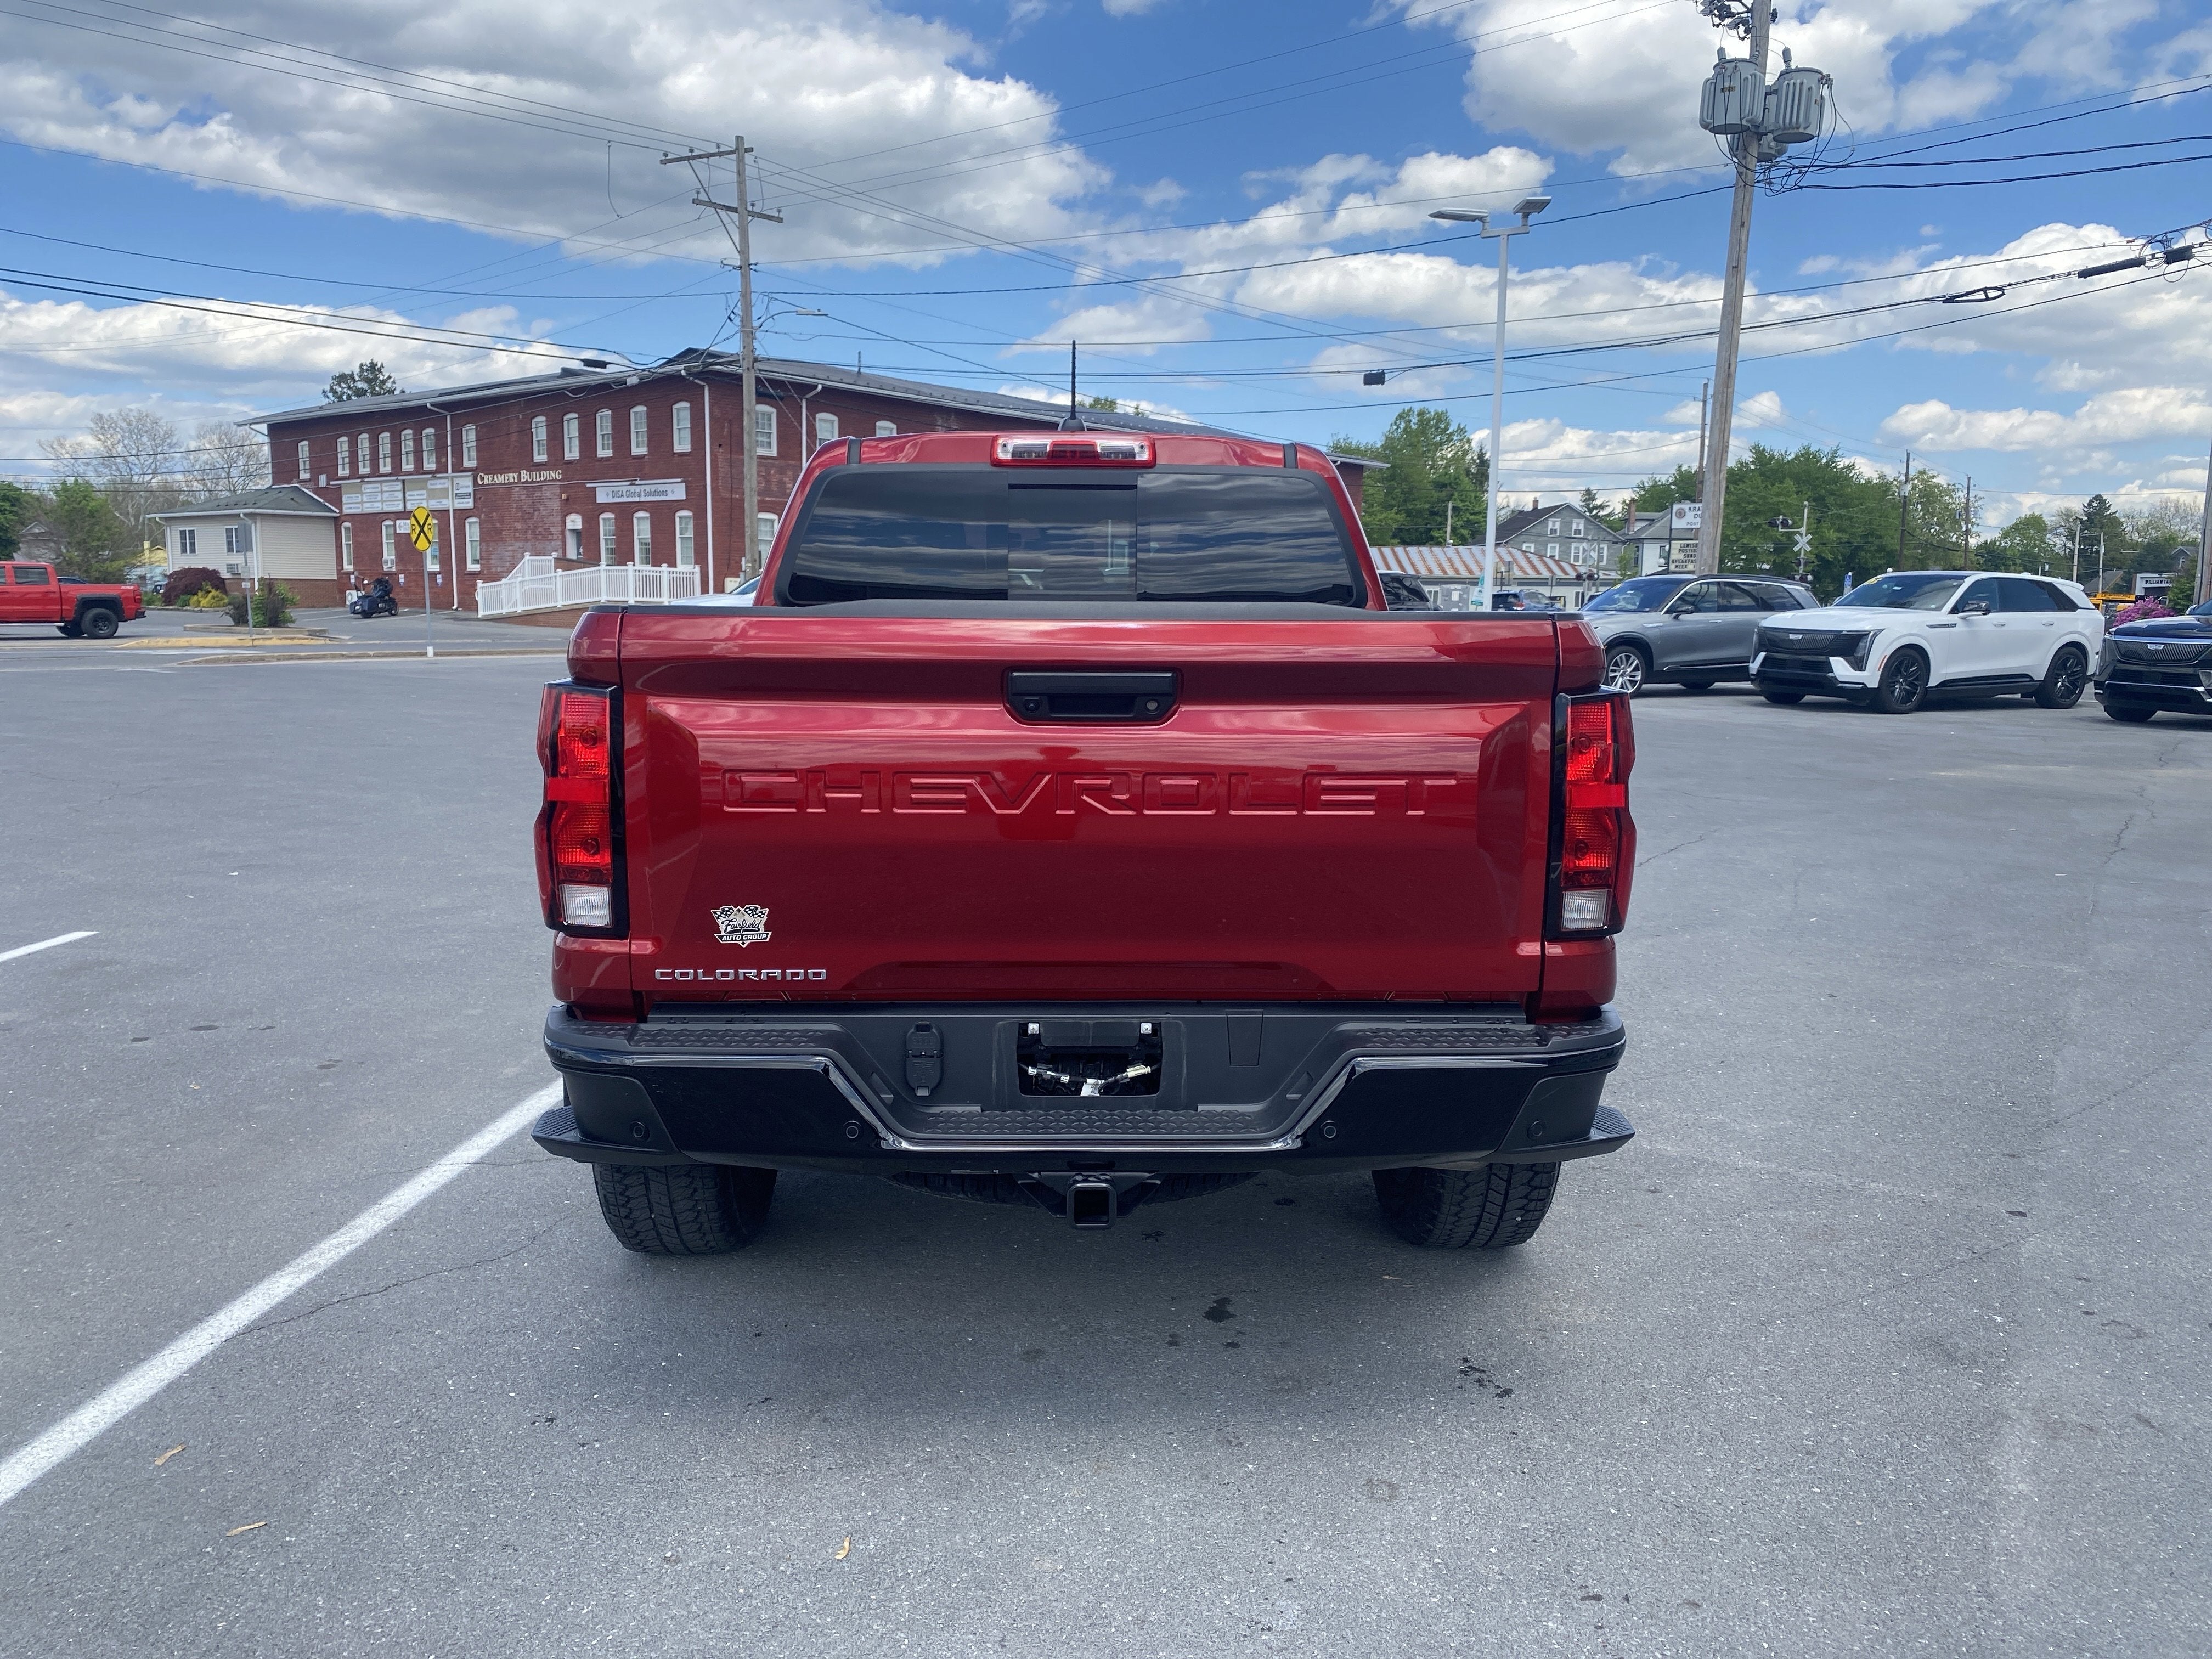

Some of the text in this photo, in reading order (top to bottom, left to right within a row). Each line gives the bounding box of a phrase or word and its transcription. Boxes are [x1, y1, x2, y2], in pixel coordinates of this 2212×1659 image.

[477, 470, 562, 484] CREAMERY BUILDING
[612, 488, 668, 498] DISA Global Solutions
[411, 523, 432, 534] R R
[720, 769, 1458, 816] CHEVROLET
[721, 918, 763, 934] Fairfield
[654, 969, 827, 980] COLORADO
